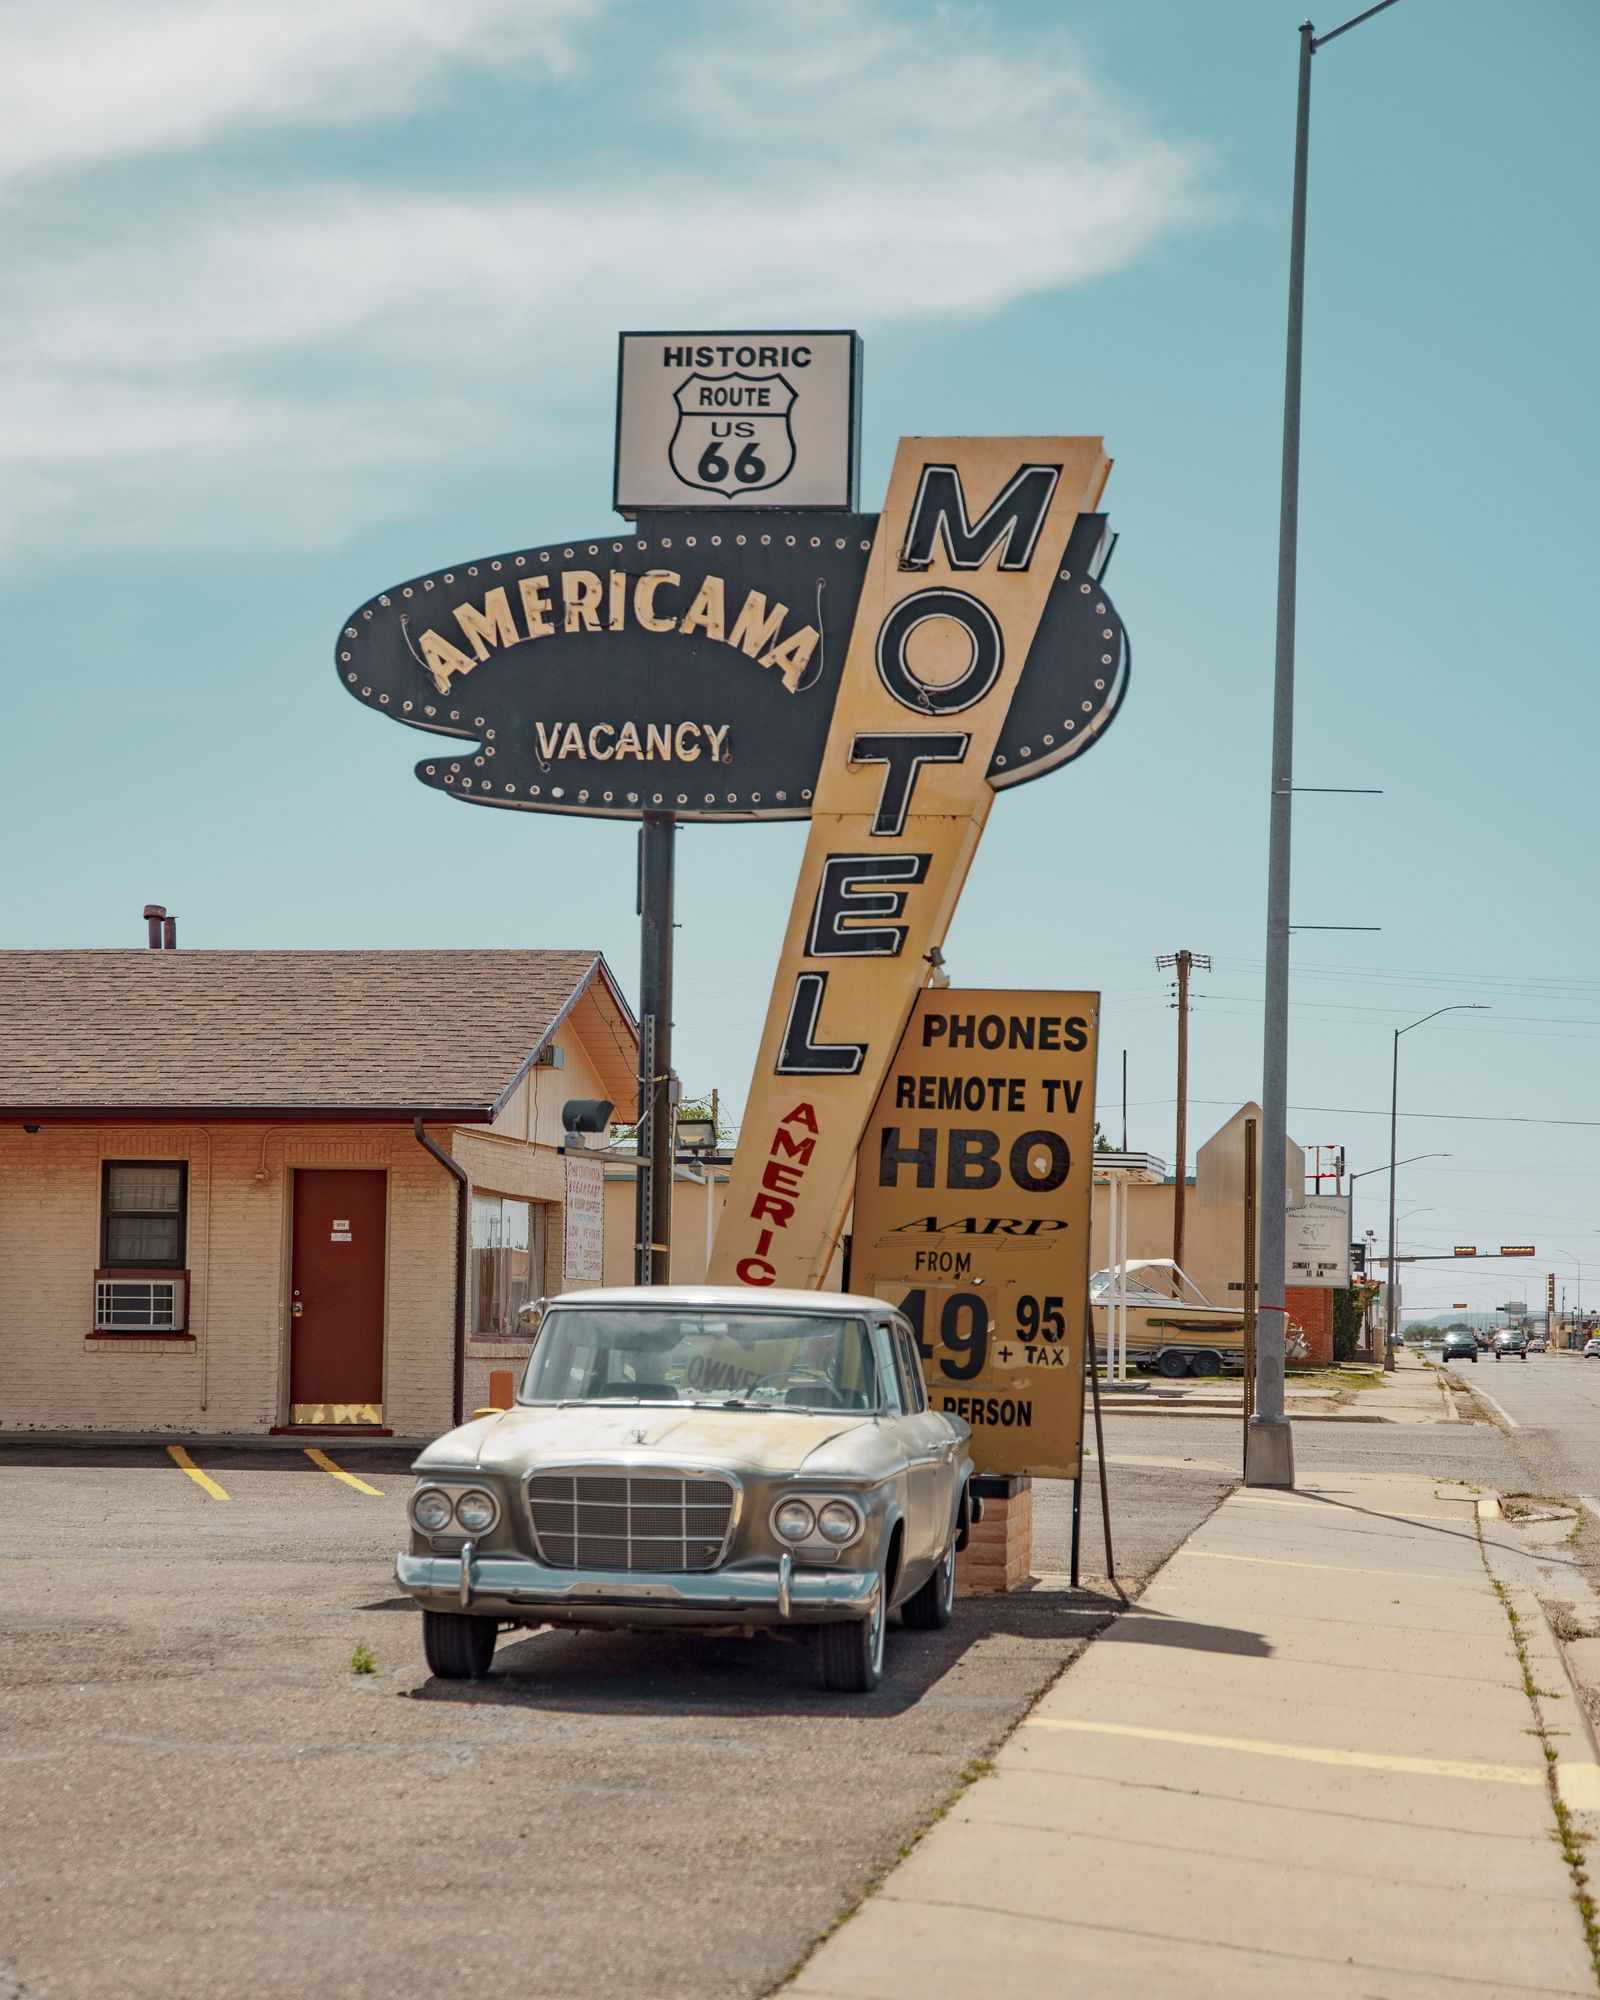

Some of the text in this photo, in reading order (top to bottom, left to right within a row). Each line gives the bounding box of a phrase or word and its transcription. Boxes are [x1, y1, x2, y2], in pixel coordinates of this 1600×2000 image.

[663, 346, 812, 368] HISTORIC
[699, 386, 771, 407] ROUTE
[711, 421, 756, 438] US
[697, 441, 766, 484] 66
[418, 568, 821, 696] AMERICANA
[535, 721, 731, 763] VACANCY
[774, 463, 1064, 1077] MOTEL
[922, 1013, 1089, 1052] PHONES
[895, 1075, 1084, 1114] REMOTE TV
[878, 1126, 1071, 1193] HBO
[889, 1216, 1070, 1236] AARP
[915, 1251, 972, 1272] FROM
[1292, 1261, 1310, 1269] SUNDAY
[896, 1289, 1066, 1381] 49 95
[1024, 1345, 1065, 1366] TAX
[943, 1396, 1032, 1427] PERSON
